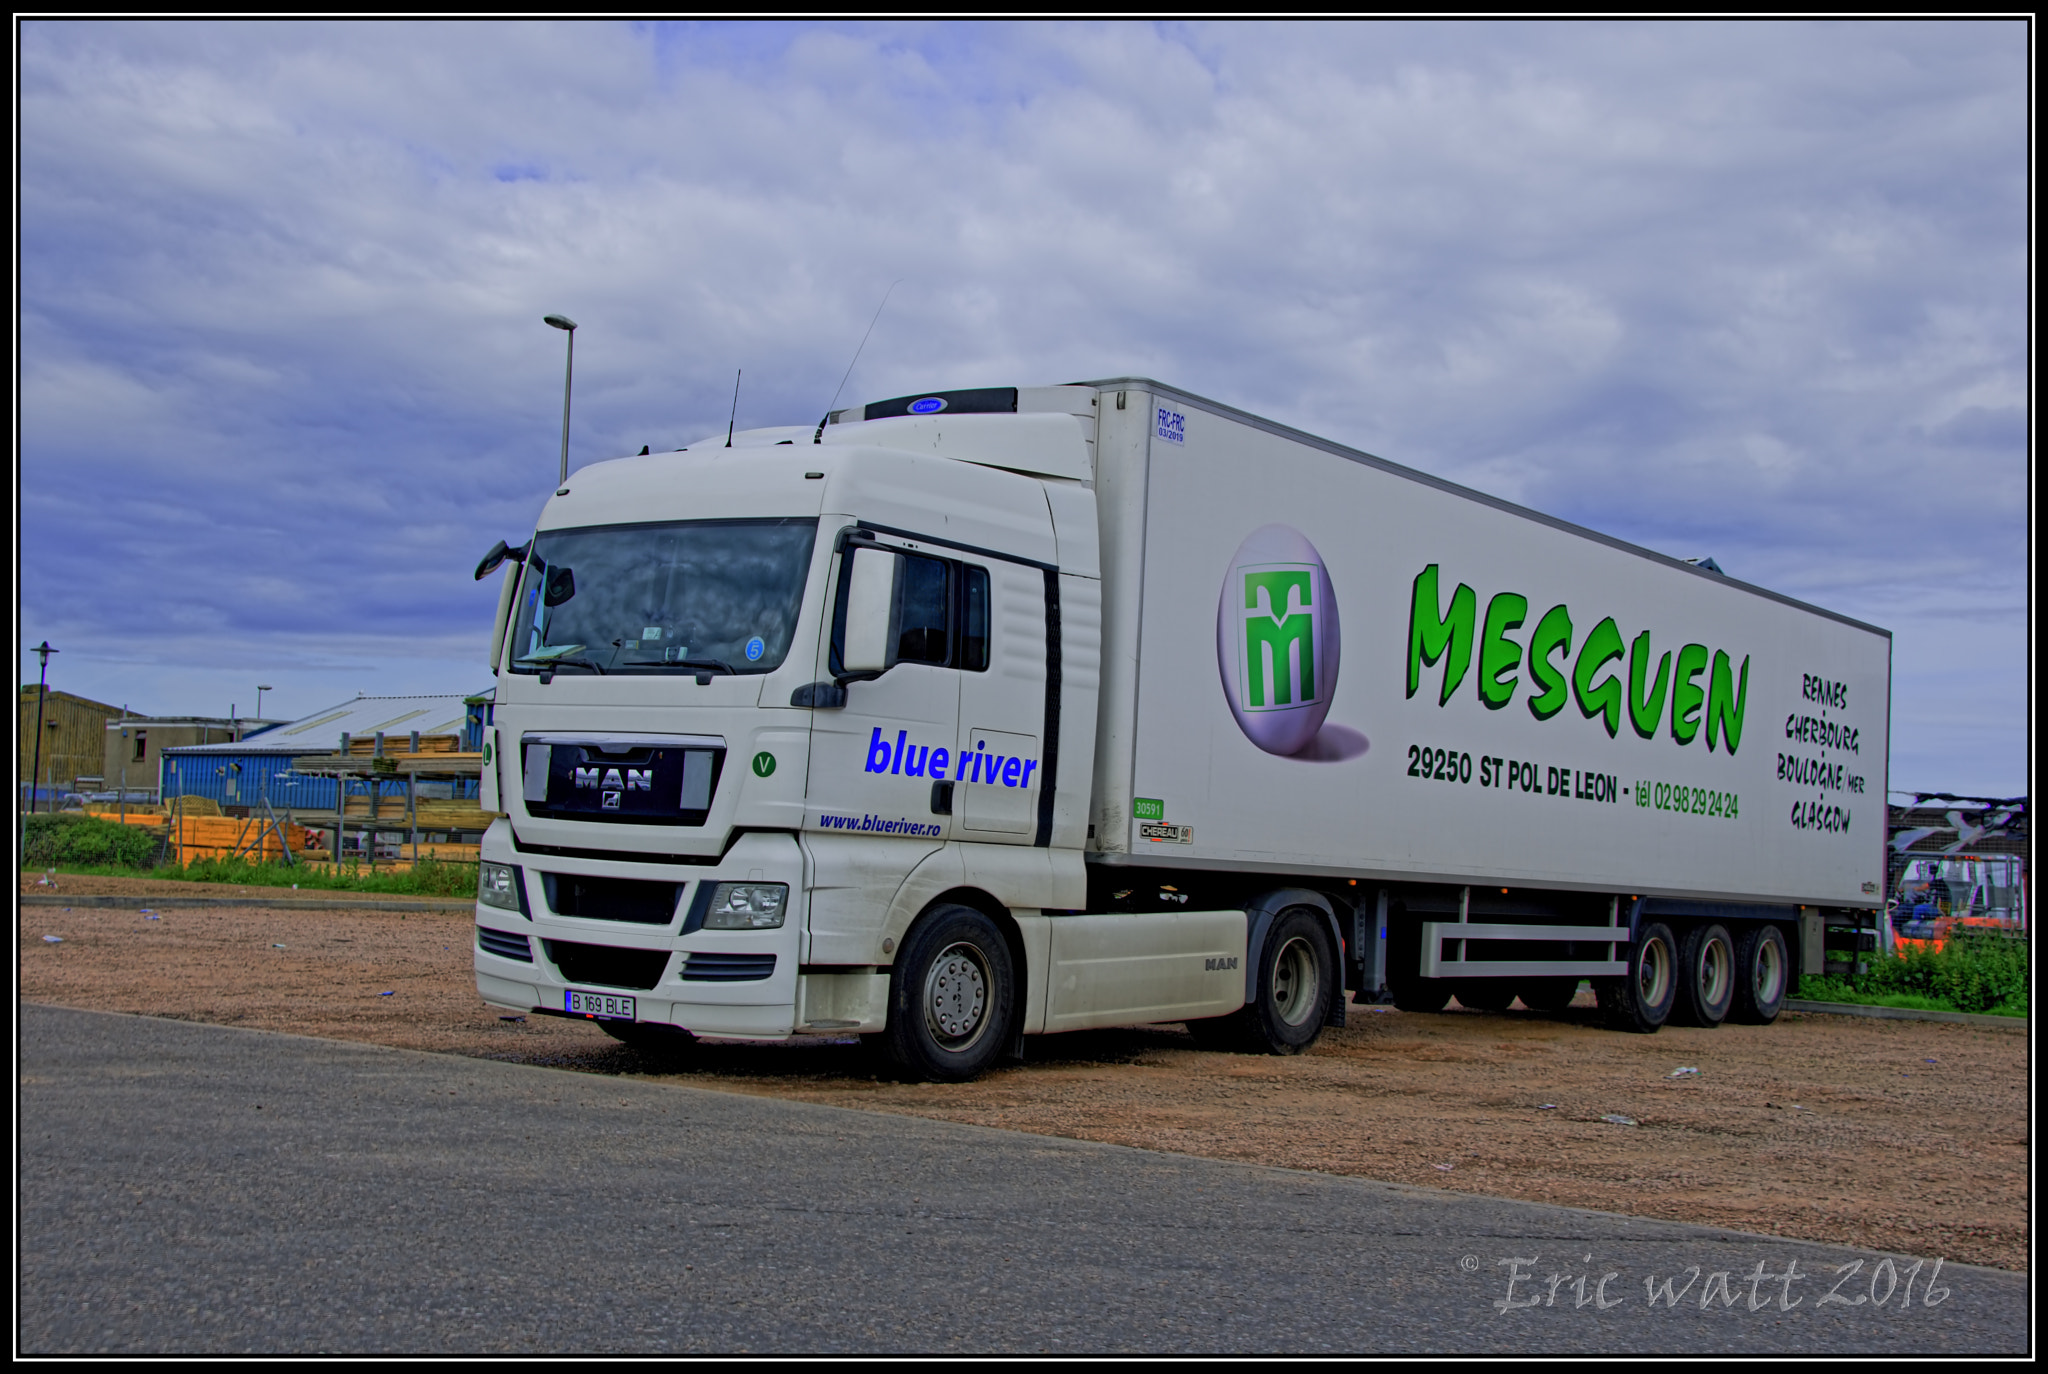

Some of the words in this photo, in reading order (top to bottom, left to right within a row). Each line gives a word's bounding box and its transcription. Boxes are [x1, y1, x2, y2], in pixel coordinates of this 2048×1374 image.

[915, 401, 938, 410] Carrier
[1158, 408, 1185, 432] FRC-FRC
[749, 644, 760, 658] 5
[1406, 563, 1750, 756] MESGUEN
[1802, 673, 1847, 710] RENNES
[1785, 713, 1859, 756] CHERBOURG
[758, 756, 771, 774] V
[864, 727, 949, 779] blue
[956, 740, 1038, 788] river
[575, 767, 653, 791] MAN
[1407, 744, 1472, 784] 29250
[1479, 755, 1503, 788] ST
[1508, 759, 1542, 794] POL
[1547, 766, 1571, 798] DE
[1575, 770, 1617, 804] LEON
[1635, 780, 1651, 807] tél
[1136, 802, 1160, 816] 30591
[1791, 800, 1851, 834] GLASGOW
[820, 813, 941, 837] www.blueriver.ro
[1142, 826, 1178, 838] CHEREAU
[1205, 957, 1238, 971] MAN
[573, 994, 581, 1009] B
[585, 995, 602, 1012] 169
[606, 998, 631, 1016] BLE
